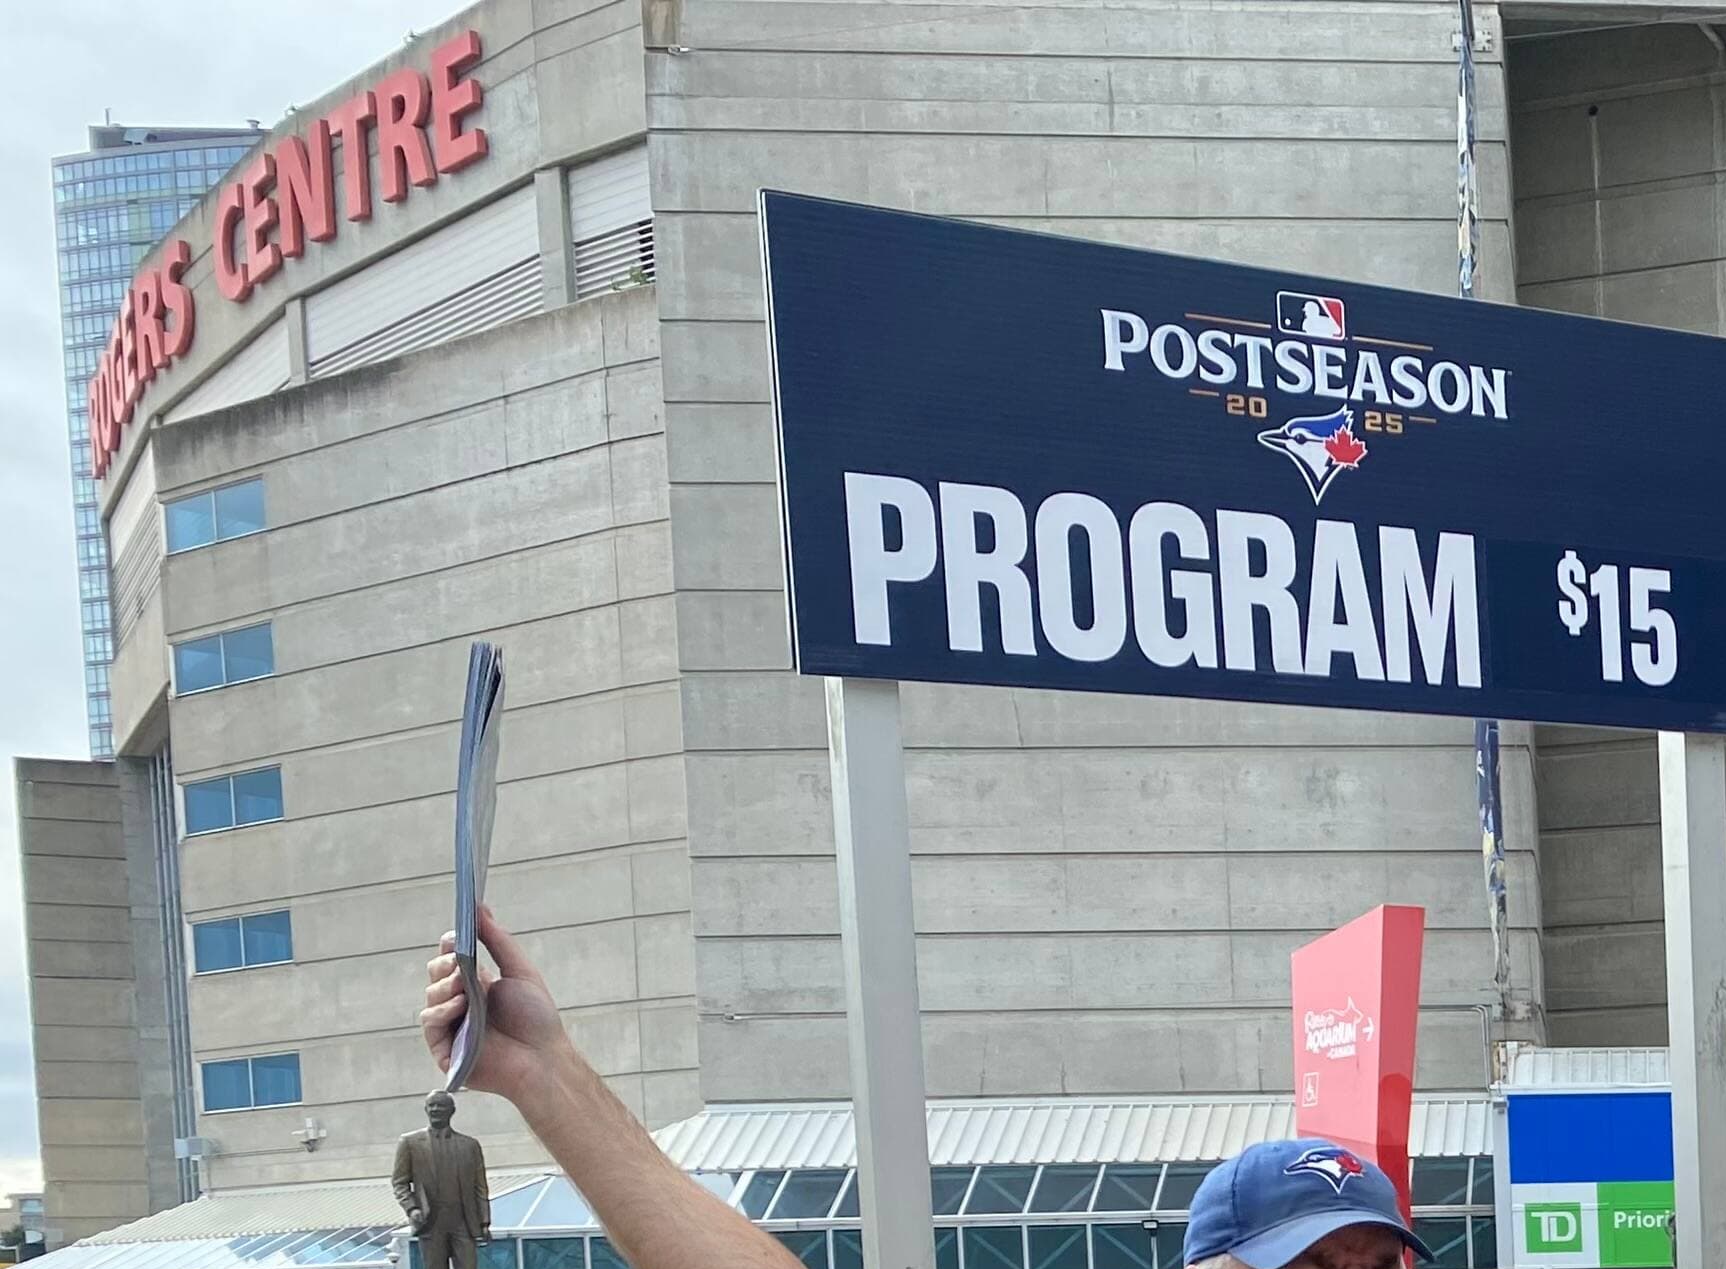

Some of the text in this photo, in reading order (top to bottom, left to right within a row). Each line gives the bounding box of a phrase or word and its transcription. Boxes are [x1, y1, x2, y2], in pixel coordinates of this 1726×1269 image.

[88, 29, 488, 480] ROGERS CENTRE
[1101, 308, 1509, 420] POSTSEASON
[1226, 394, 1404, 433] 20 25
[844, 471, 1483, 689] PROGRAM
[1557, 549, 1678, 688] $15
[1531, 1211, 1577, 1242] TD
[1614, 1210, 1671, 1229] Priori
